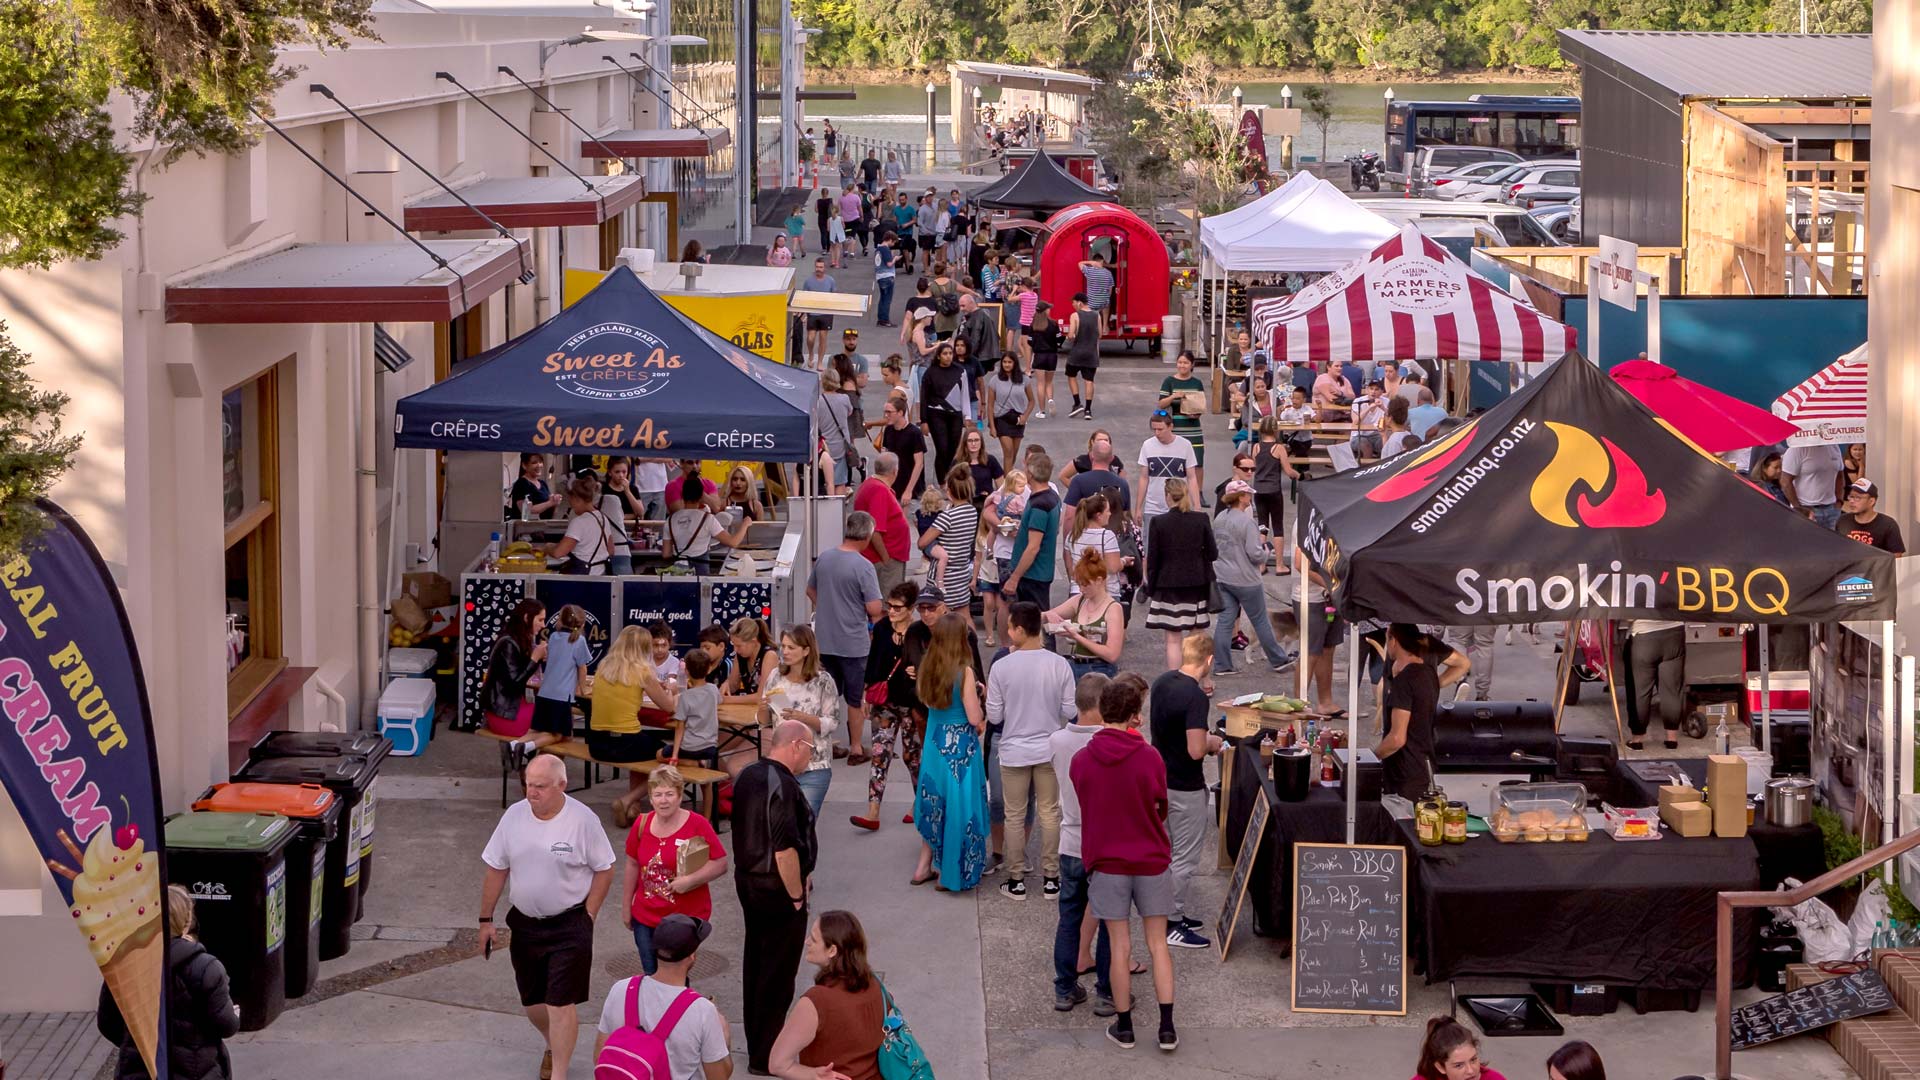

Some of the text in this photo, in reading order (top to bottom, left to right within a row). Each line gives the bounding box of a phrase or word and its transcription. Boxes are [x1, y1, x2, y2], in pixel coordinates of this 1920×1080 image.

[1402, 267, 1429, 275] CATALINA
[1372, 280, 1462, 291] FARMERS
[1380, 288, 1456, 298] MARKET
[567, 325, 659, 347] NEW ZEALAND MADE
[542, 348, 686, 373] Sweet As
[581, 369, 649, 381] CRÊPES
[575, 387, 648, 398] FLIPPIN' GOOD
[430, 419, 501, 440] CRÊPES
[532, 415, 673, 449] Sweet As
[704, 428, 775, 449] CRÊPES
[1794, 429, 1818, 438] LITTLE
[1410, 418, 1537, 533] smokinbbq.co.nz
[0, 557, 58, 640] EAL
[1676, 566, 1790, 616] BBQ
[629, 608, 694, 623] Flippin' good
[588, 624, 609, 641] As
[49, 640, 129, 756] FRUIT
[0, 657, 112, 844] CREAM
[1349, 850, 1396, 875] BBQ
[1348, 884, 1372, 911] Bun
[1384, 890, 1401, 905] $15
[1357, 919, 1377, 941] Roll
[1299, 978, 1400, 1000] Lamb Roast Roll $15
